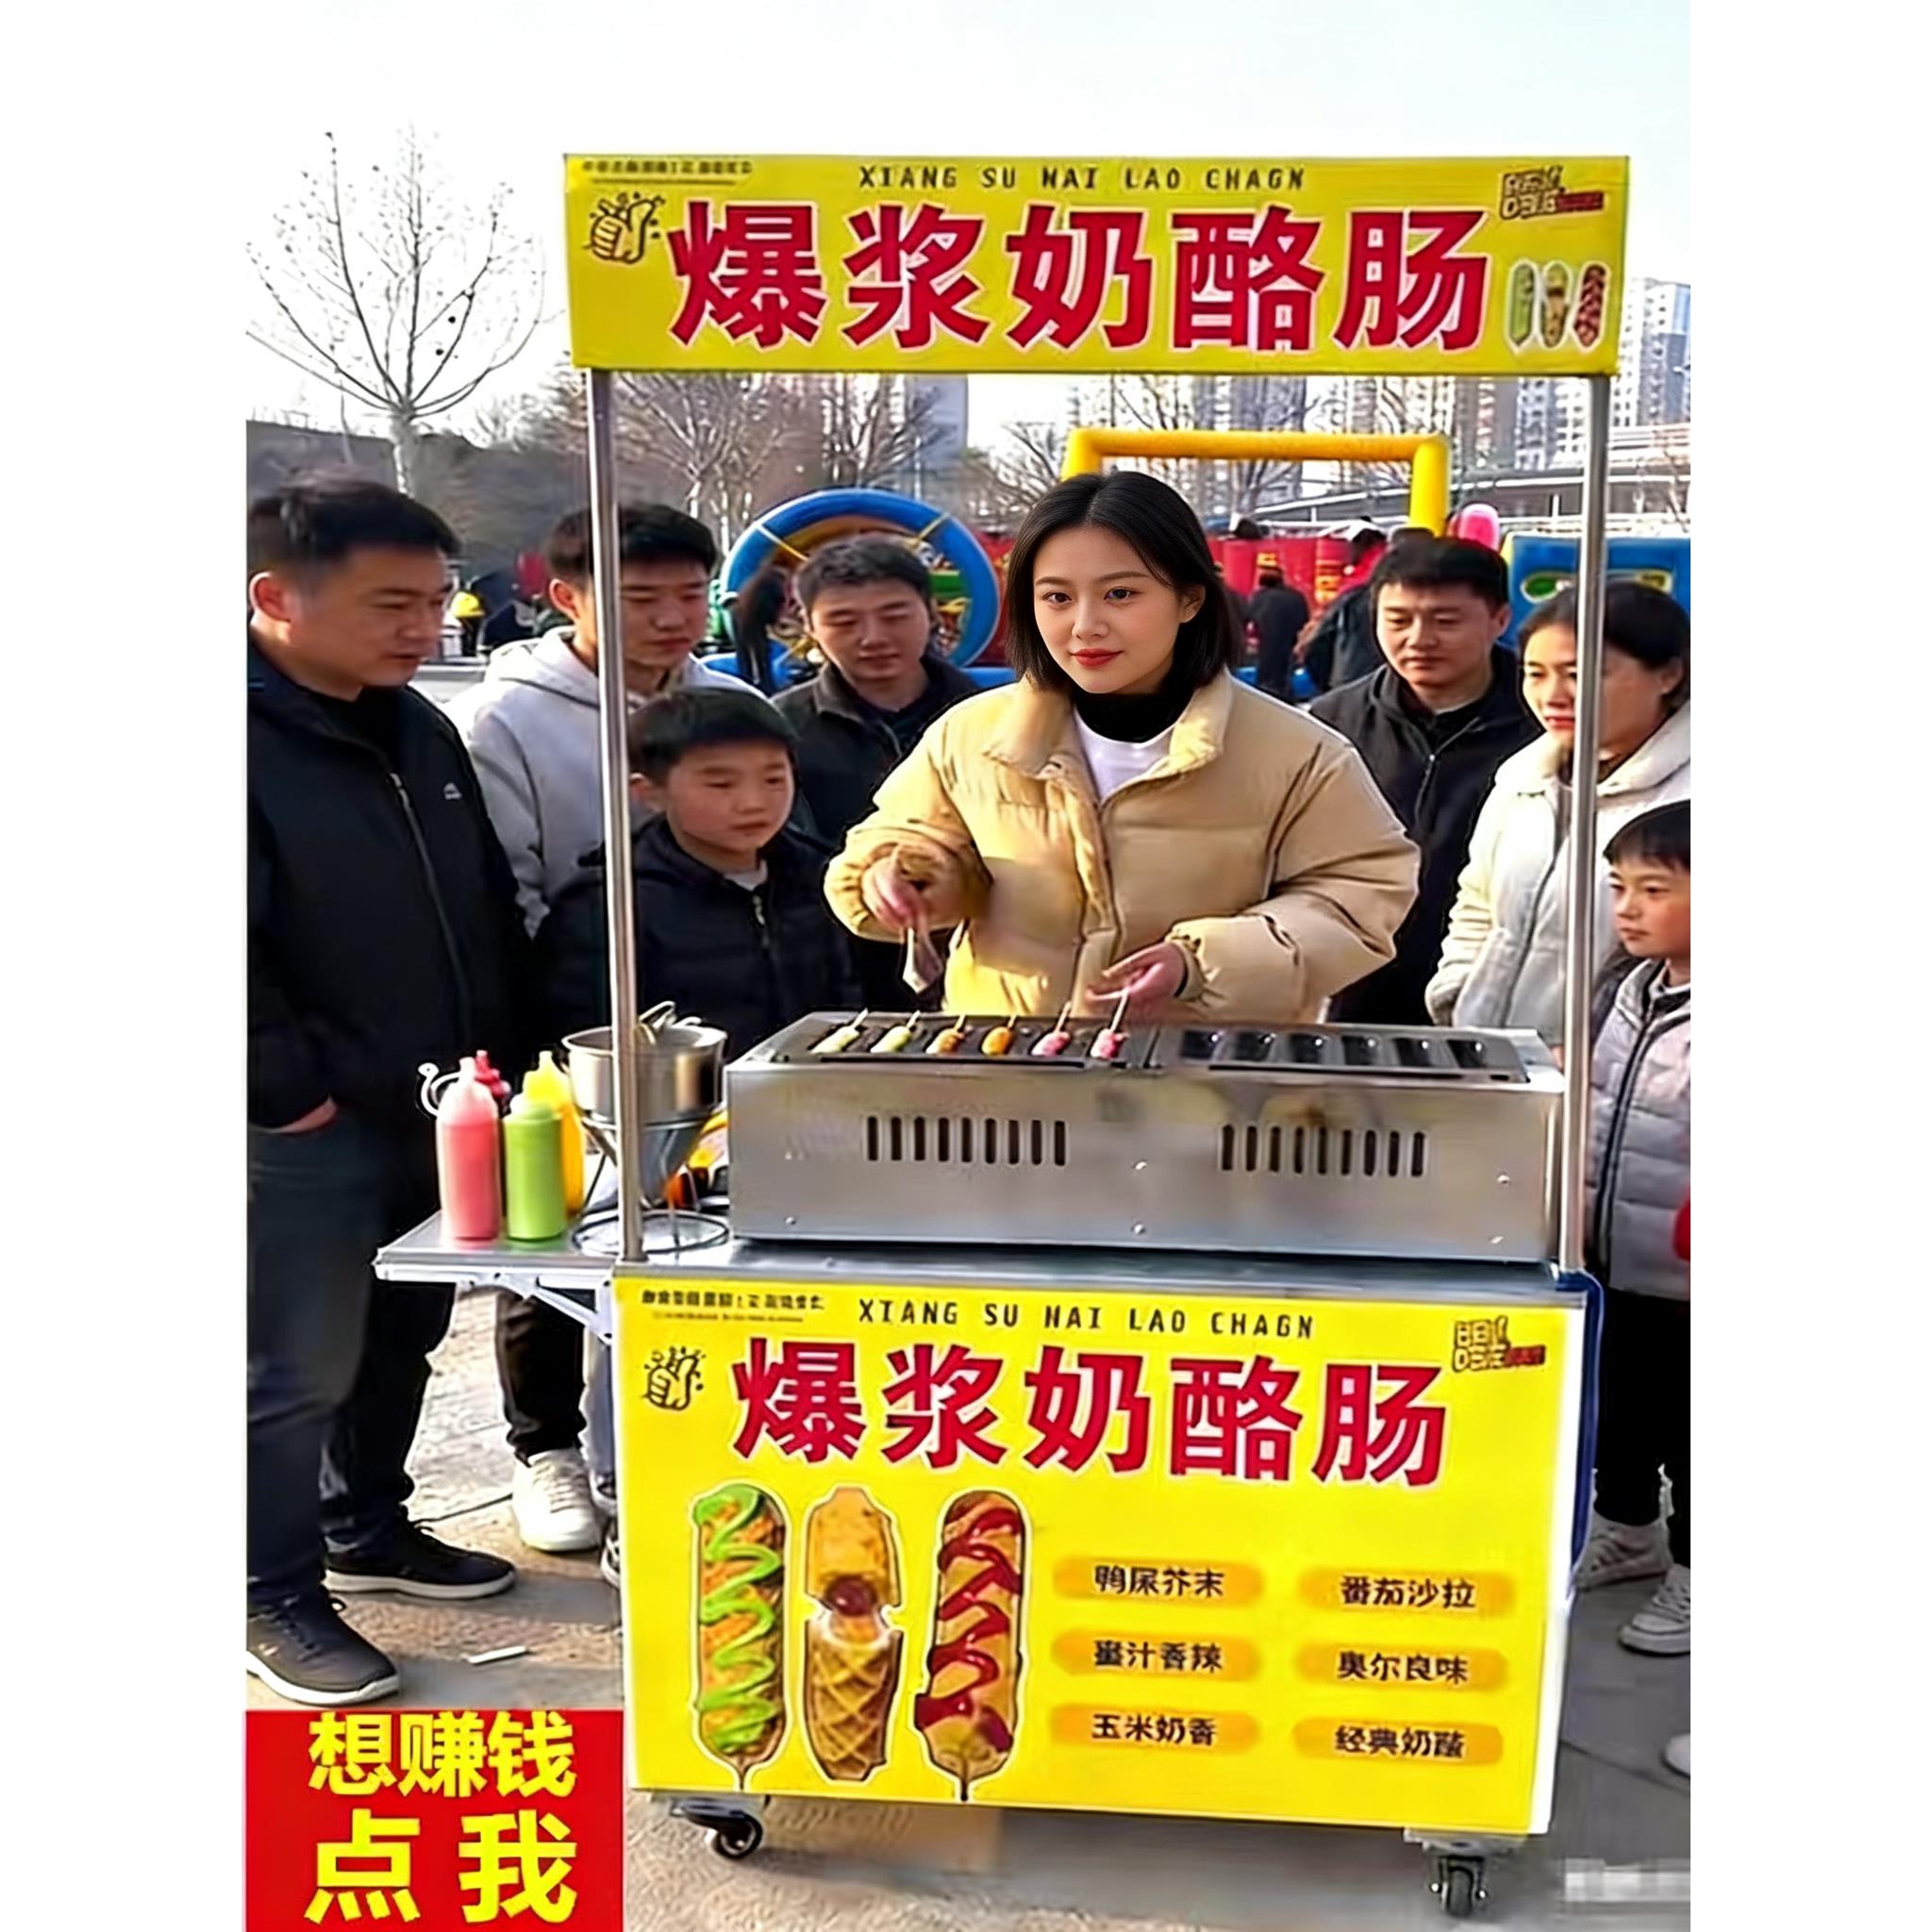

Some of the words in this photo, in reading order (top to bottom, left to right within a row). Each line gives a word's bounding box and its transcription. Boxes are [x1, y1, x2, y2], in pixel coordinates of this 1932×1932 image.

[858, 165, 958, 190] XIANG
[981, 166, 1017, 190] SU
[1041, 165, 1098, 191] NAI
[1124, 166, 1181, 191] LAO
[666, 200, 1491, 351] 爆浆奶酪肠
[858, 1298, 958, 1325] XIANG
[984, 1302, 1019, 1328] SU
[1043, 1304, 1101, 1330] NAI
[1128, 1307, 1187, 1334] LAO
[731, 1338, 1447, 1487] 爆浆奶酪肠
[1341, 1575, 1475, 1609] 番茄沙拉
[1338, 1650, 1468, 1685] 奥尔良味
[1092, 1713, 1217, 1746] 玉米奶香
